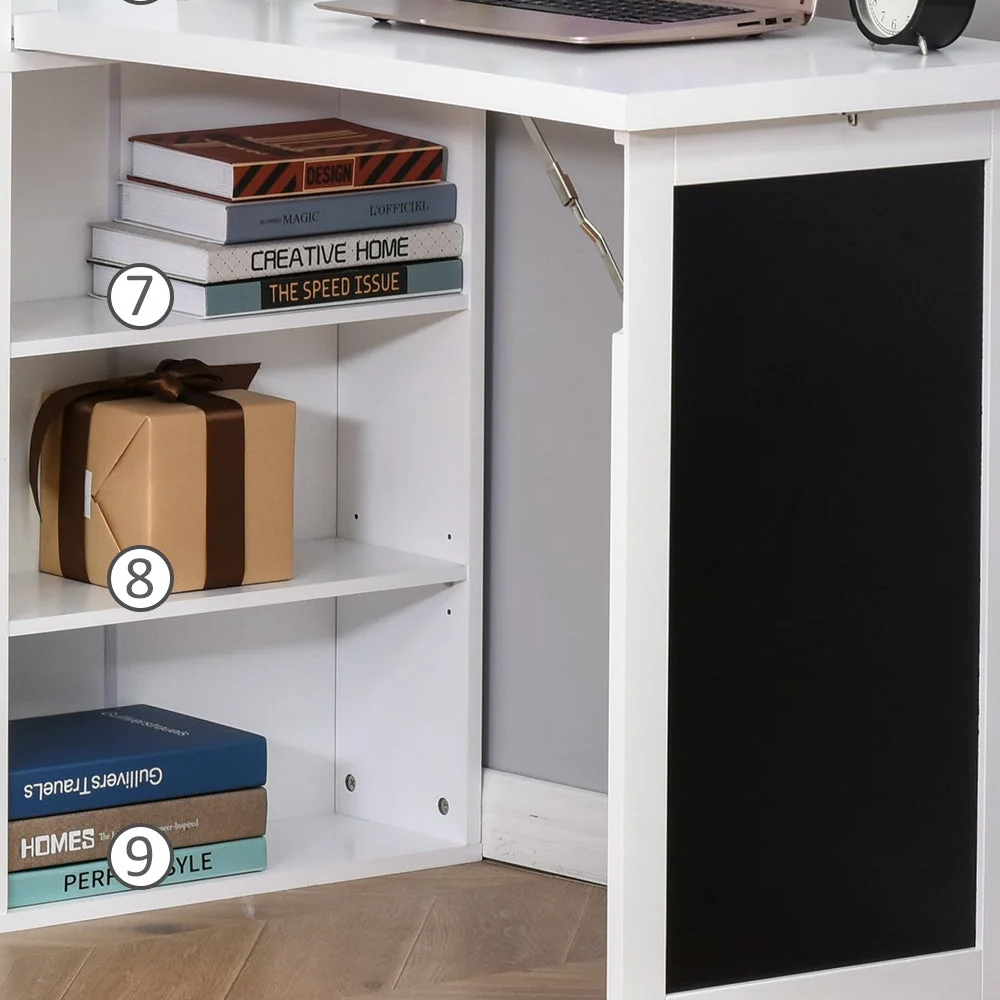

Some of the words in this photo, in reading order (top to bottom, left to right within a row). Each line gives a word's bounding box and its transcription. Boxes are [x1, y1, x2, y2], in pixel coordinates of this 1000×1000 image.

[306, 163, 352, 185] DESIGN
[282, 210, 320, 225] MAGIC
[369, 201, 429, 216] L'OFFICIEL
[251, 241, 347, 272] CREATIVE
[356, 236, 409, 261] HOME
[269, 282, 299, 303] THE
[303, 277, 350, 300] SPEED
[354, 272, 400, 295] ISSUE
[20, 828, 95, 859] HOMES
